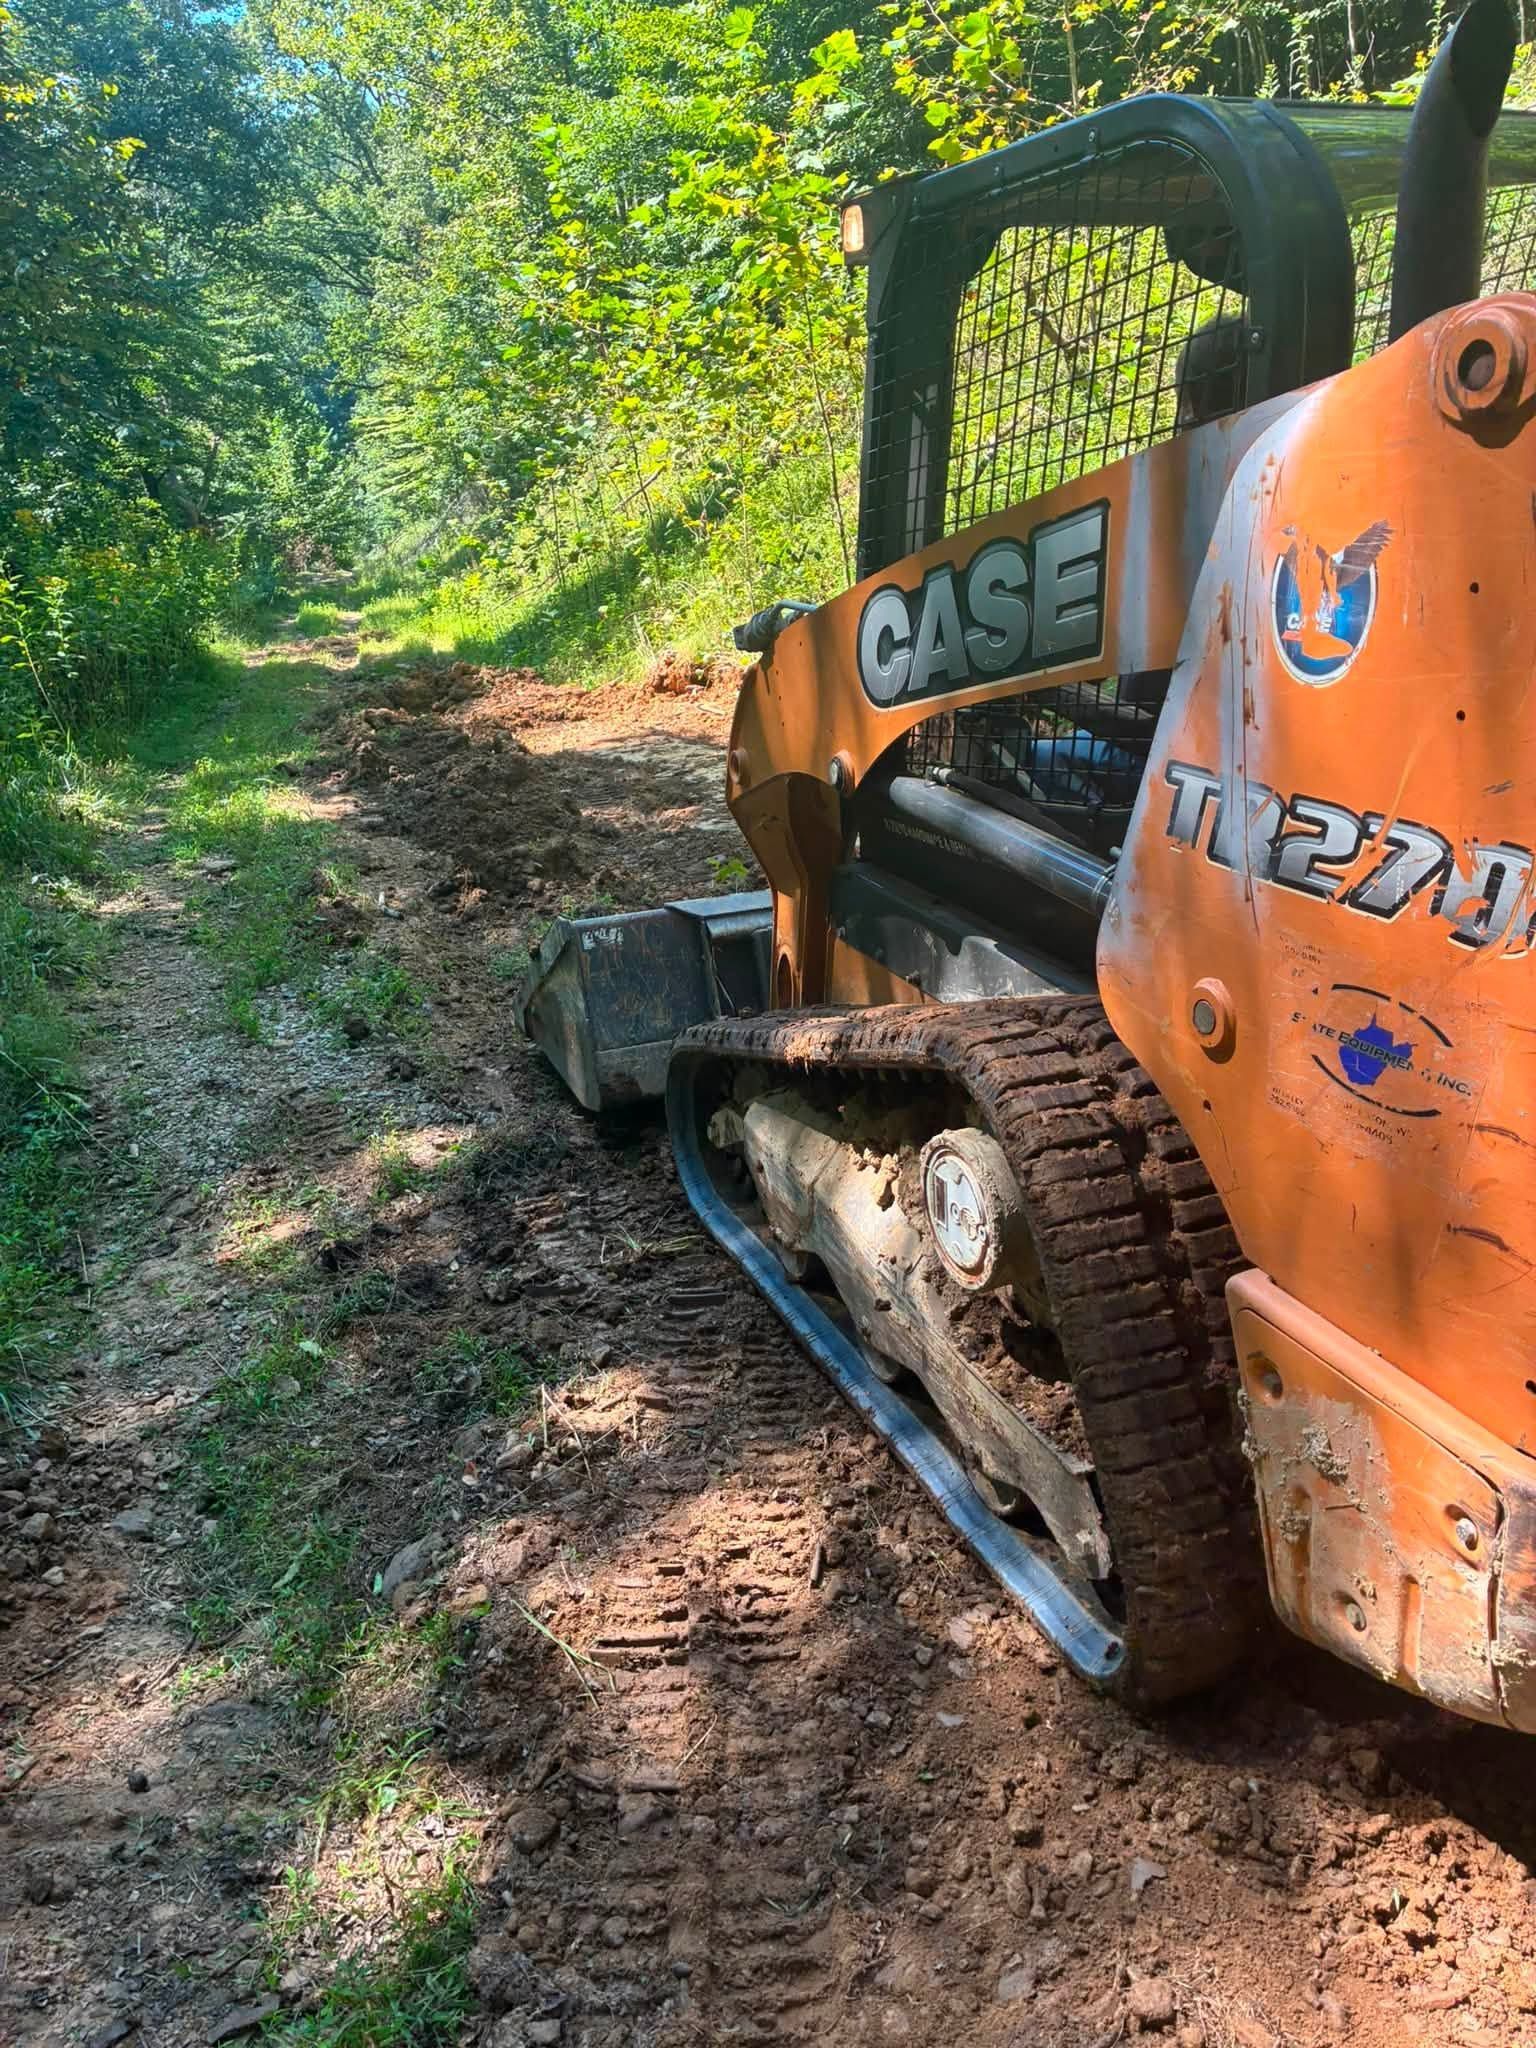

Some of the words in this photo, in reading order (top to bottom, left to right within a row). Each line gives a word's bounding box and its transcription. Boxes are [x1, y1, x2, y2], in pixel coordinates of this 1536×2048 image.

[858, 499, 1109, 706] CASE
[1166, 760, 1535, 957] TR270
[1437, 1072, 1472, 1097] INC.
